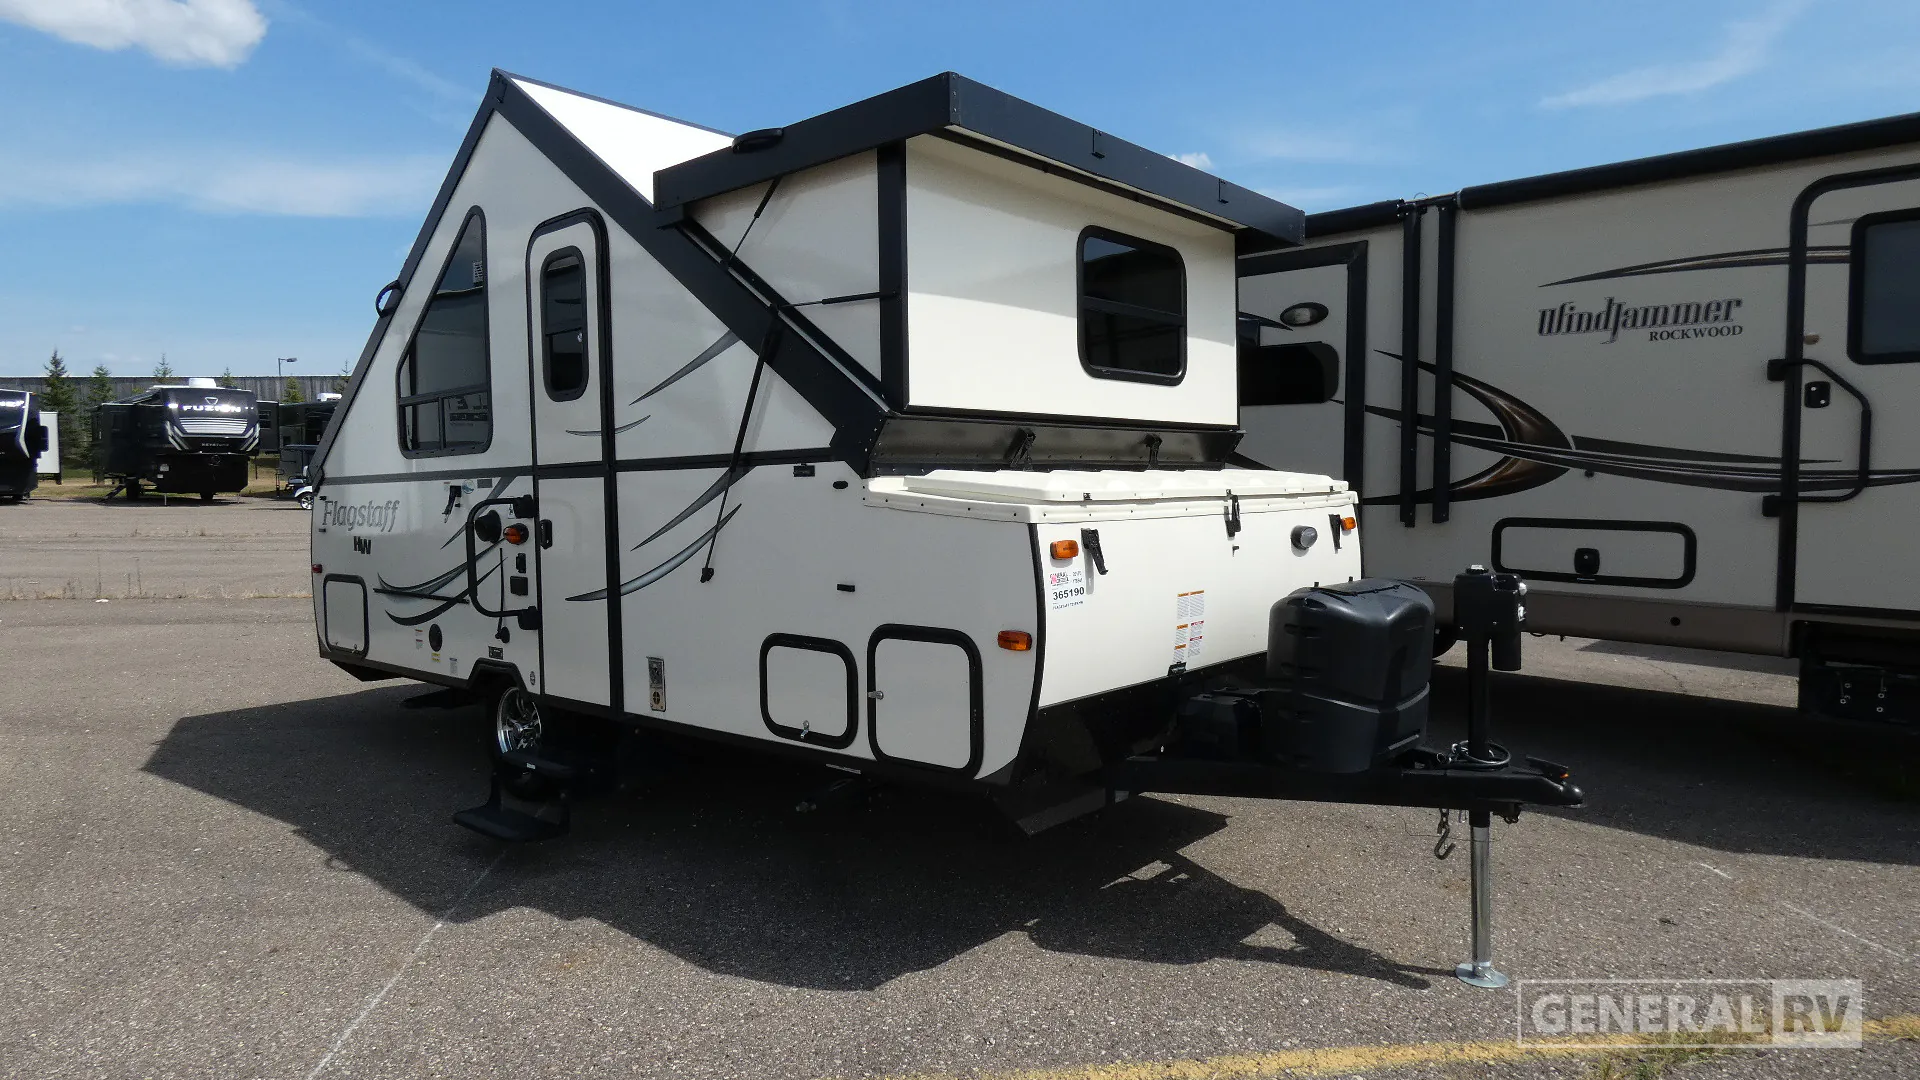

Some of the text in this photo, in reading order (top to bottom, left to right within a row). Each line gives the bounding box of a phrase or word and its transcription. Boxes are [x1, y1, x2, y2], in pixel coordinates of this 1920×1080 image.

[1649, 325, 1744, 341] ROCKWOOD
[182, 403, 241, 413] FUZION
[321, 499, 401, 533] Flagstaff
[353, 536, 372, 555] HW
[1052, 586, 1085, 601] 365190
